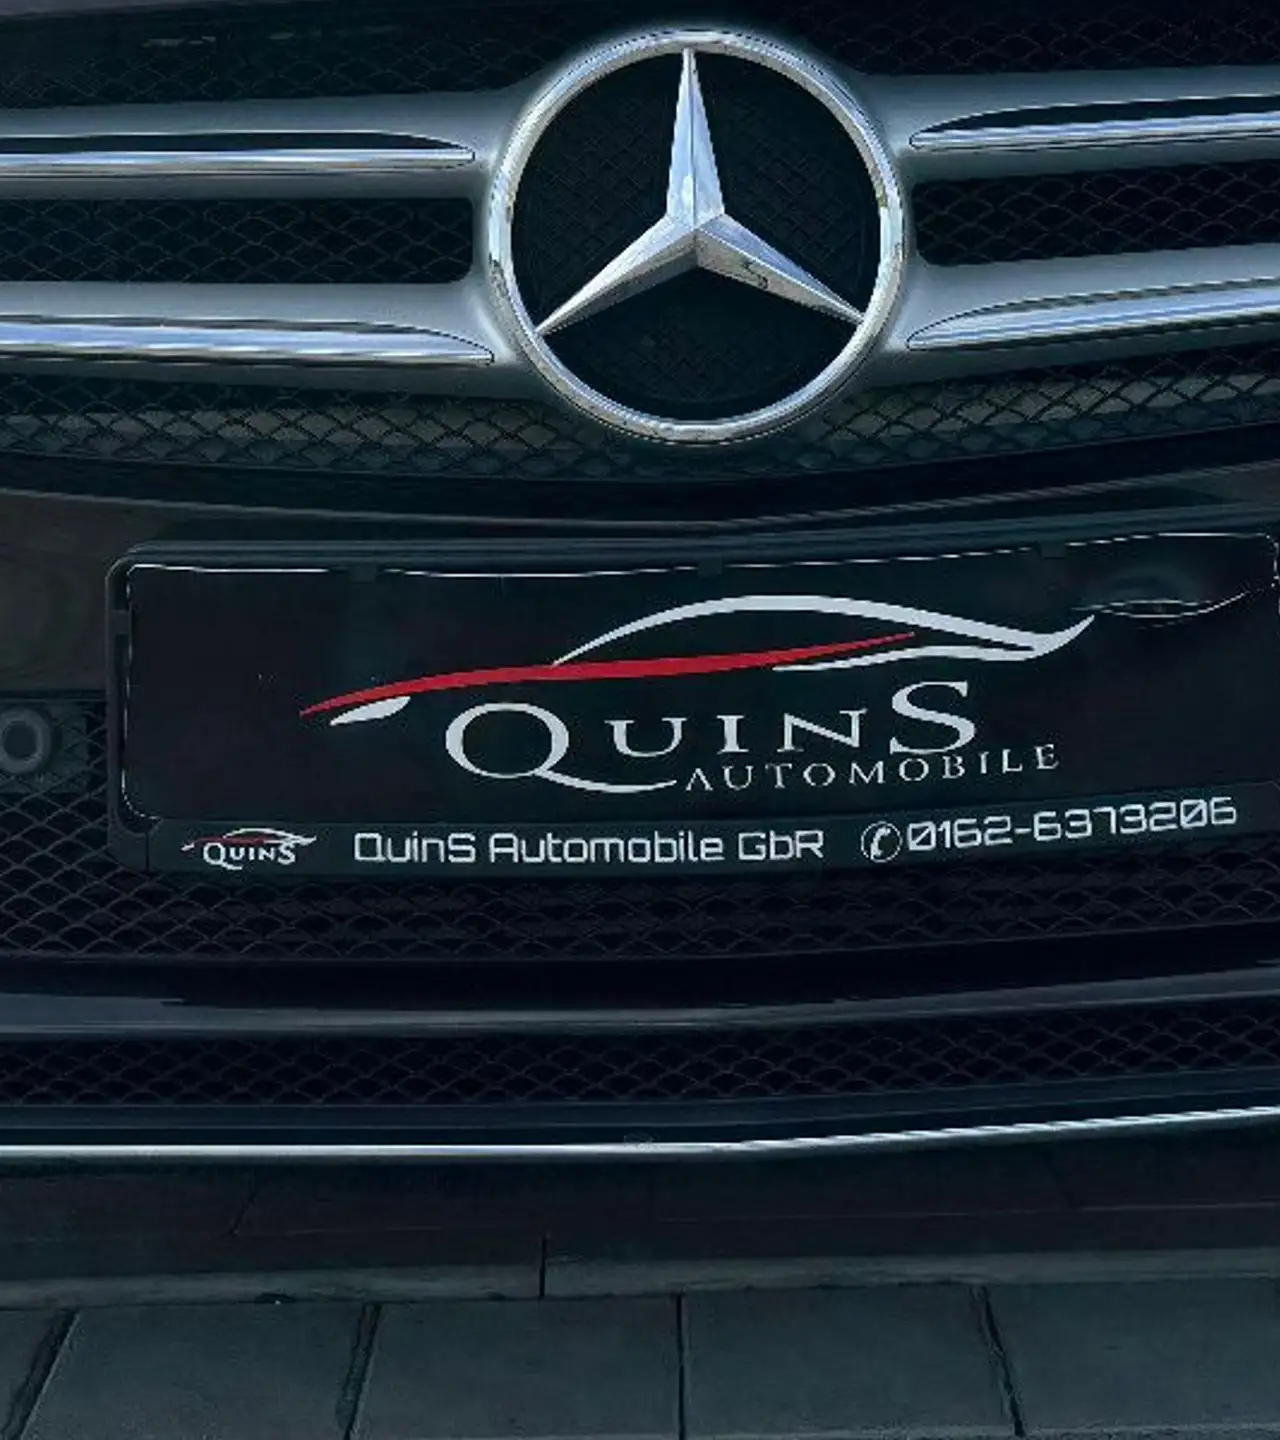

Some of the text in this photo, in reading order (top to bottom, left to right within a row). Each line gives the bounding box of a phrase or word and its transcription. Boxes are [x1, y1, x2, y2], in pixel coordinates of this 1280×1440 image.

[685, 745, 1060, 791] AUTOMOBILE
[354, 796, 1237, 863] QuinS Automobile GbR 0162-6373206
